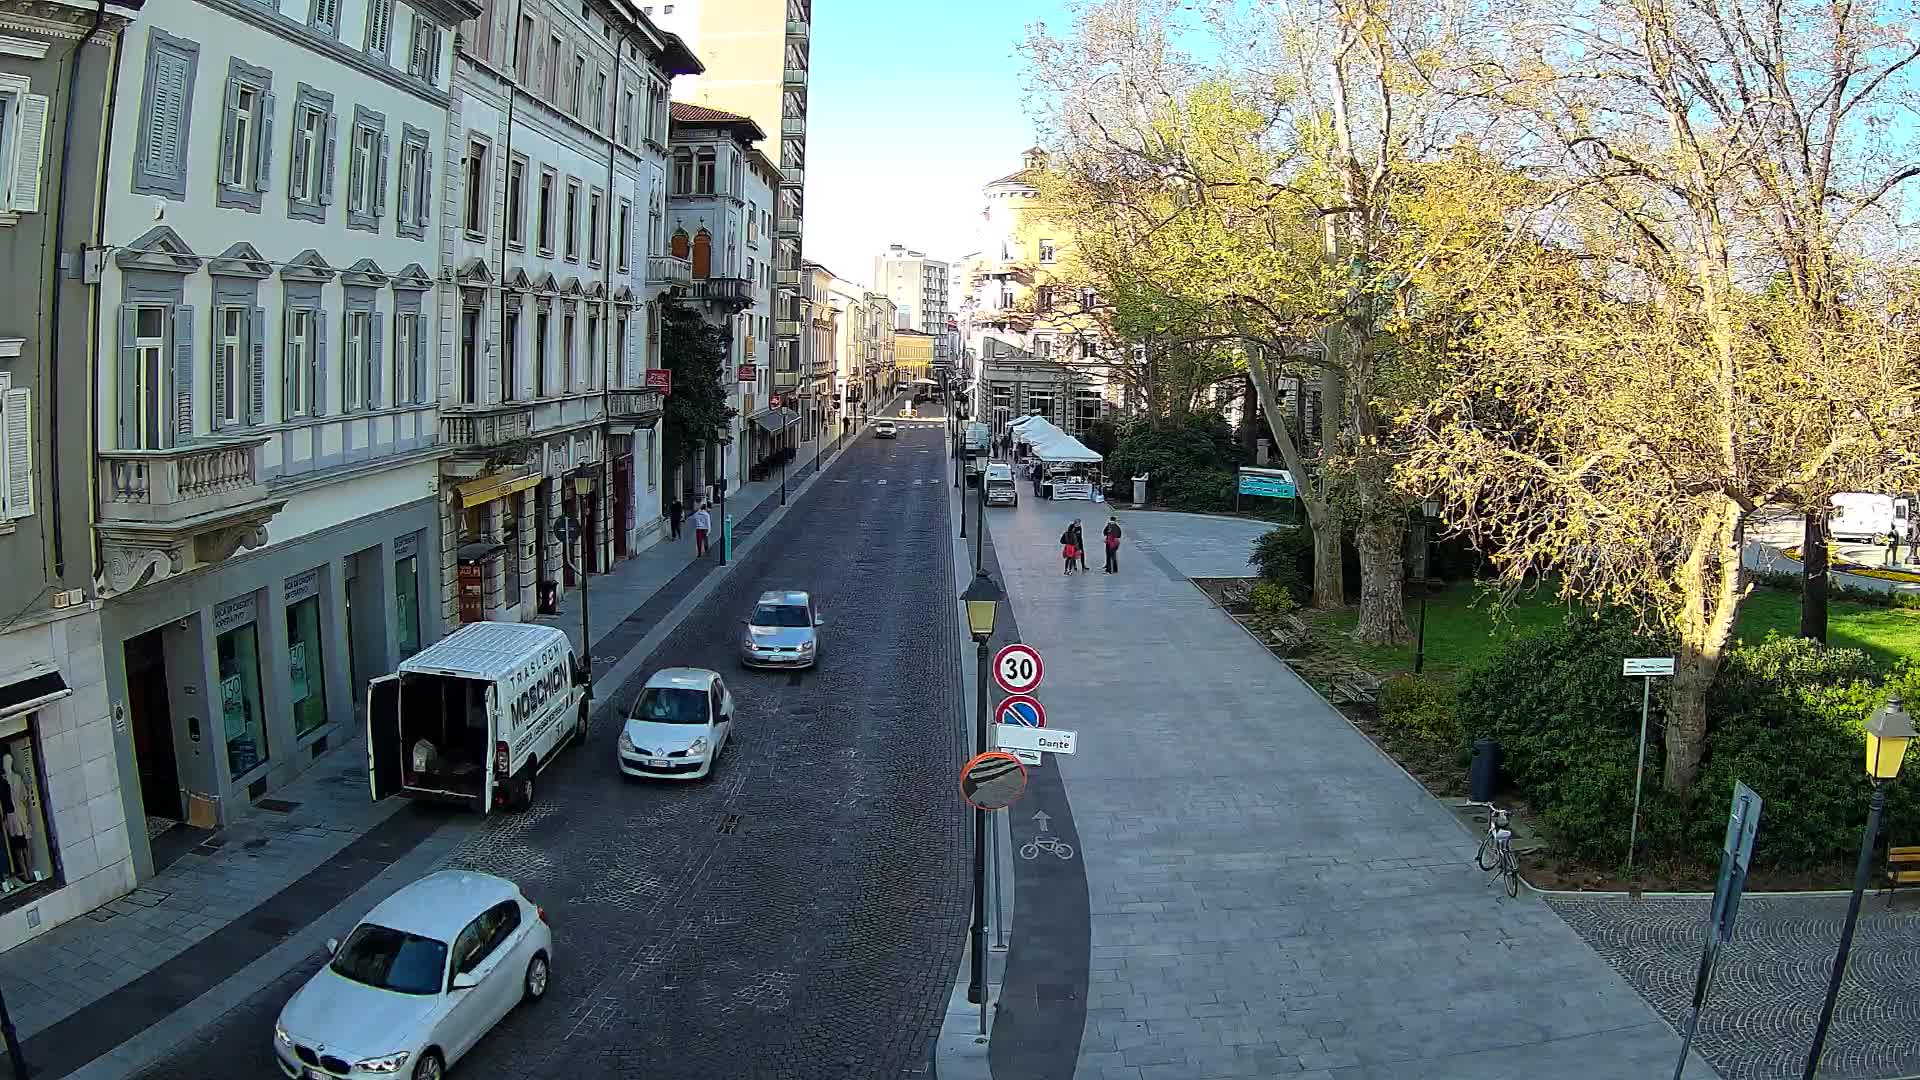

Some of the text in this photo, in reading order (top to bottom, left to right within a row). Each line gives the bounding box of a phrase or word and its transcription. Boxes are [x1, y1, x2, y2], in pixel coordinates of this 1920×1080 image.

[1005, 657, 1033, 680] 30
[510, 660, 568, 732] MOSCHION
[1038, 737, 1070, 749] Dante
